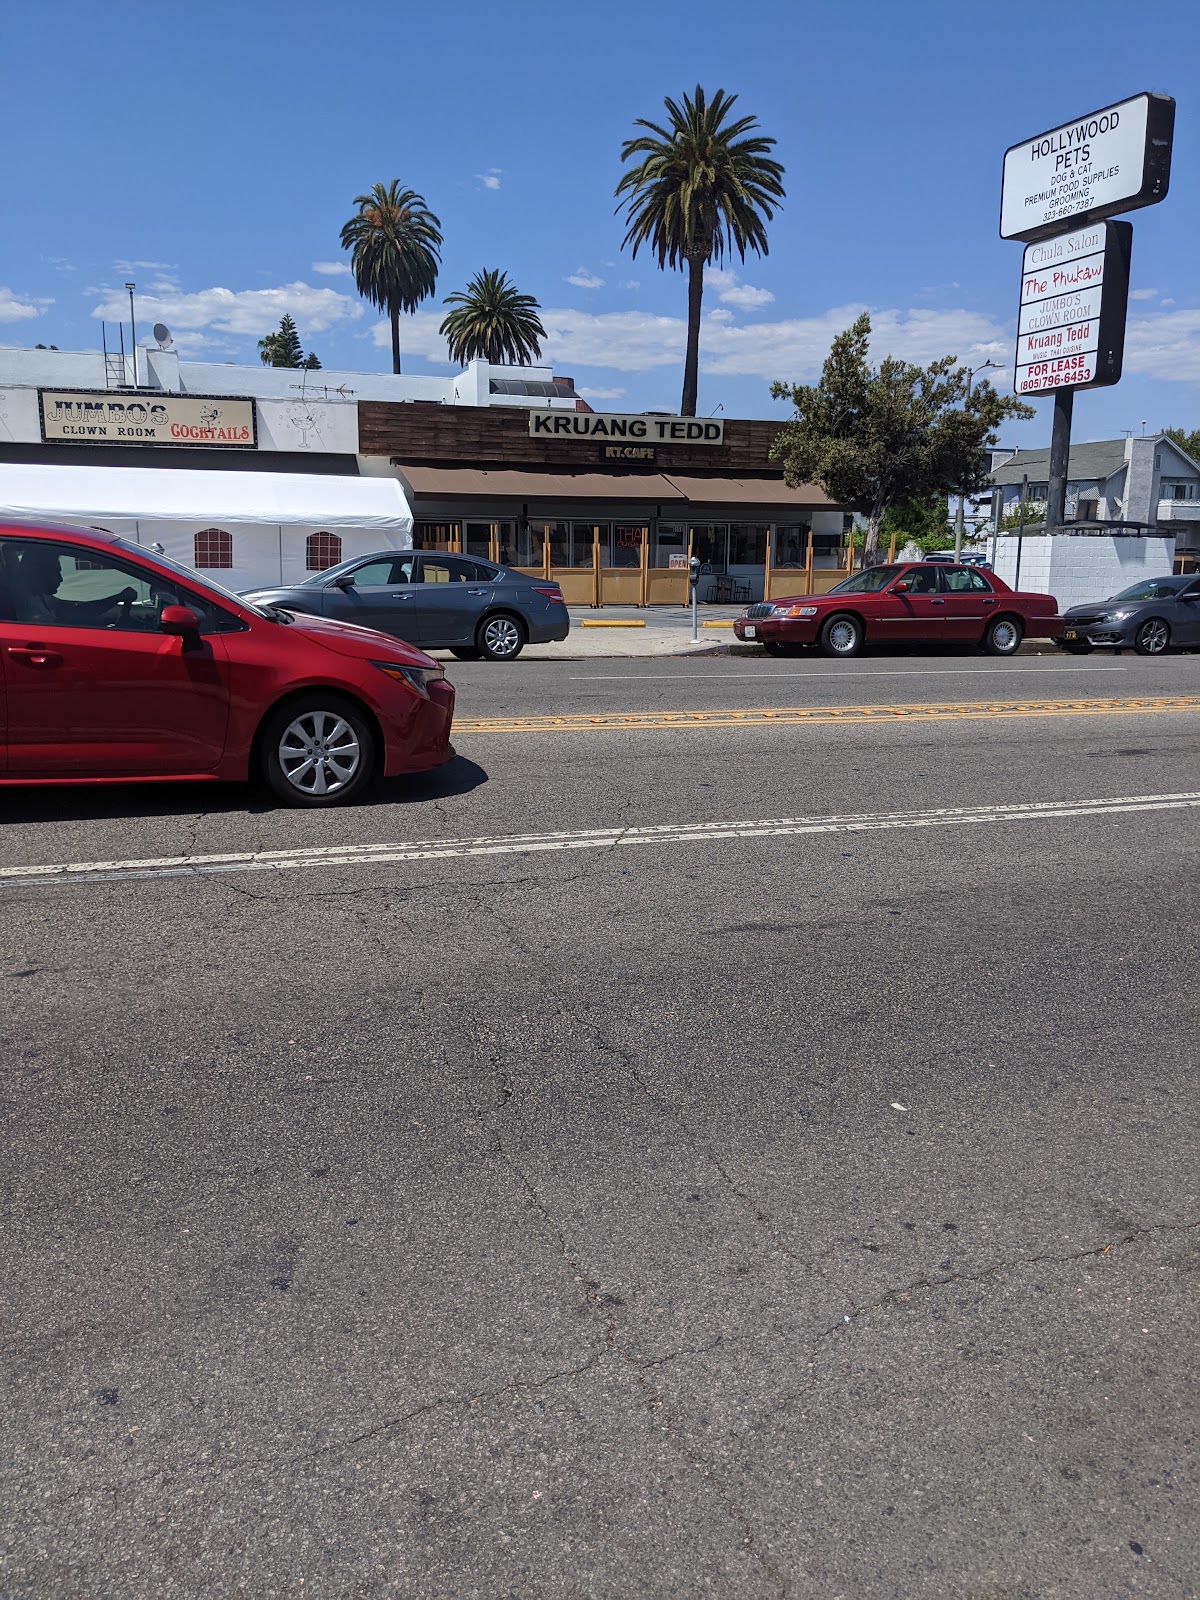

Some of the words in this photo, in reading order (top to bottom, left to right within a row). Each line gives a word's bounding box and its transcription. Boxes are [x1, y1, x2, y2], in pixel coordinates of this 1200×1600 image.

[1031, 112, 1120, 161] HOLLYWOOD
[1055, 144, 1090, 172] PETS
[1024, 187, 1057, 207] PREMIUM
[1058, 180, 1080, 195] FOOD
[1082, 165, 1120, 187] SUPPLIES
[1050, 172, 1067, 186] DOG
[1069, 169, 1075, 179] &
[1077, 162, 1093, 176] CAT
[1042, 196, 1095, 222] 323-660-7387
[1048, 187, 1090, 209] GROOMING
[1031, 243, 1063, 264] Chula
[1067, 233, 1099, 254] Salon
[1025, 279, 1048, 297] The
[1039, 293, 1081, 314] JUMBO'S
[1028, 312, 1060, 330] CLOWN
[1063, 305, 1091, 321] ROOM
[1027, 332, 1063, 350] Kruang
[1066, 323, 1090, 343] Tedd
[1032, 351, 1048, 360] MUSIC
[1050, 348, 1062, 357] THAI
[1062, 344, 1082, 354] CUISINE
[1027, 363, 1049, 378] FOR
[1051, 356, 1085, 373] LEASE
[46, 400, 170, 426] JUMBO'S
[62, 425, 108, 436] CLOWN
[117, 427, 157, 437] ROOM
[170, 423, 250, 440] COCKTAILS
[534, 415, 647, 437] KRUANG
[655, 420, 721, 440] TEDD
[616, 526, 642, 541] THA
[669, 560, 686, 568] OPEN
